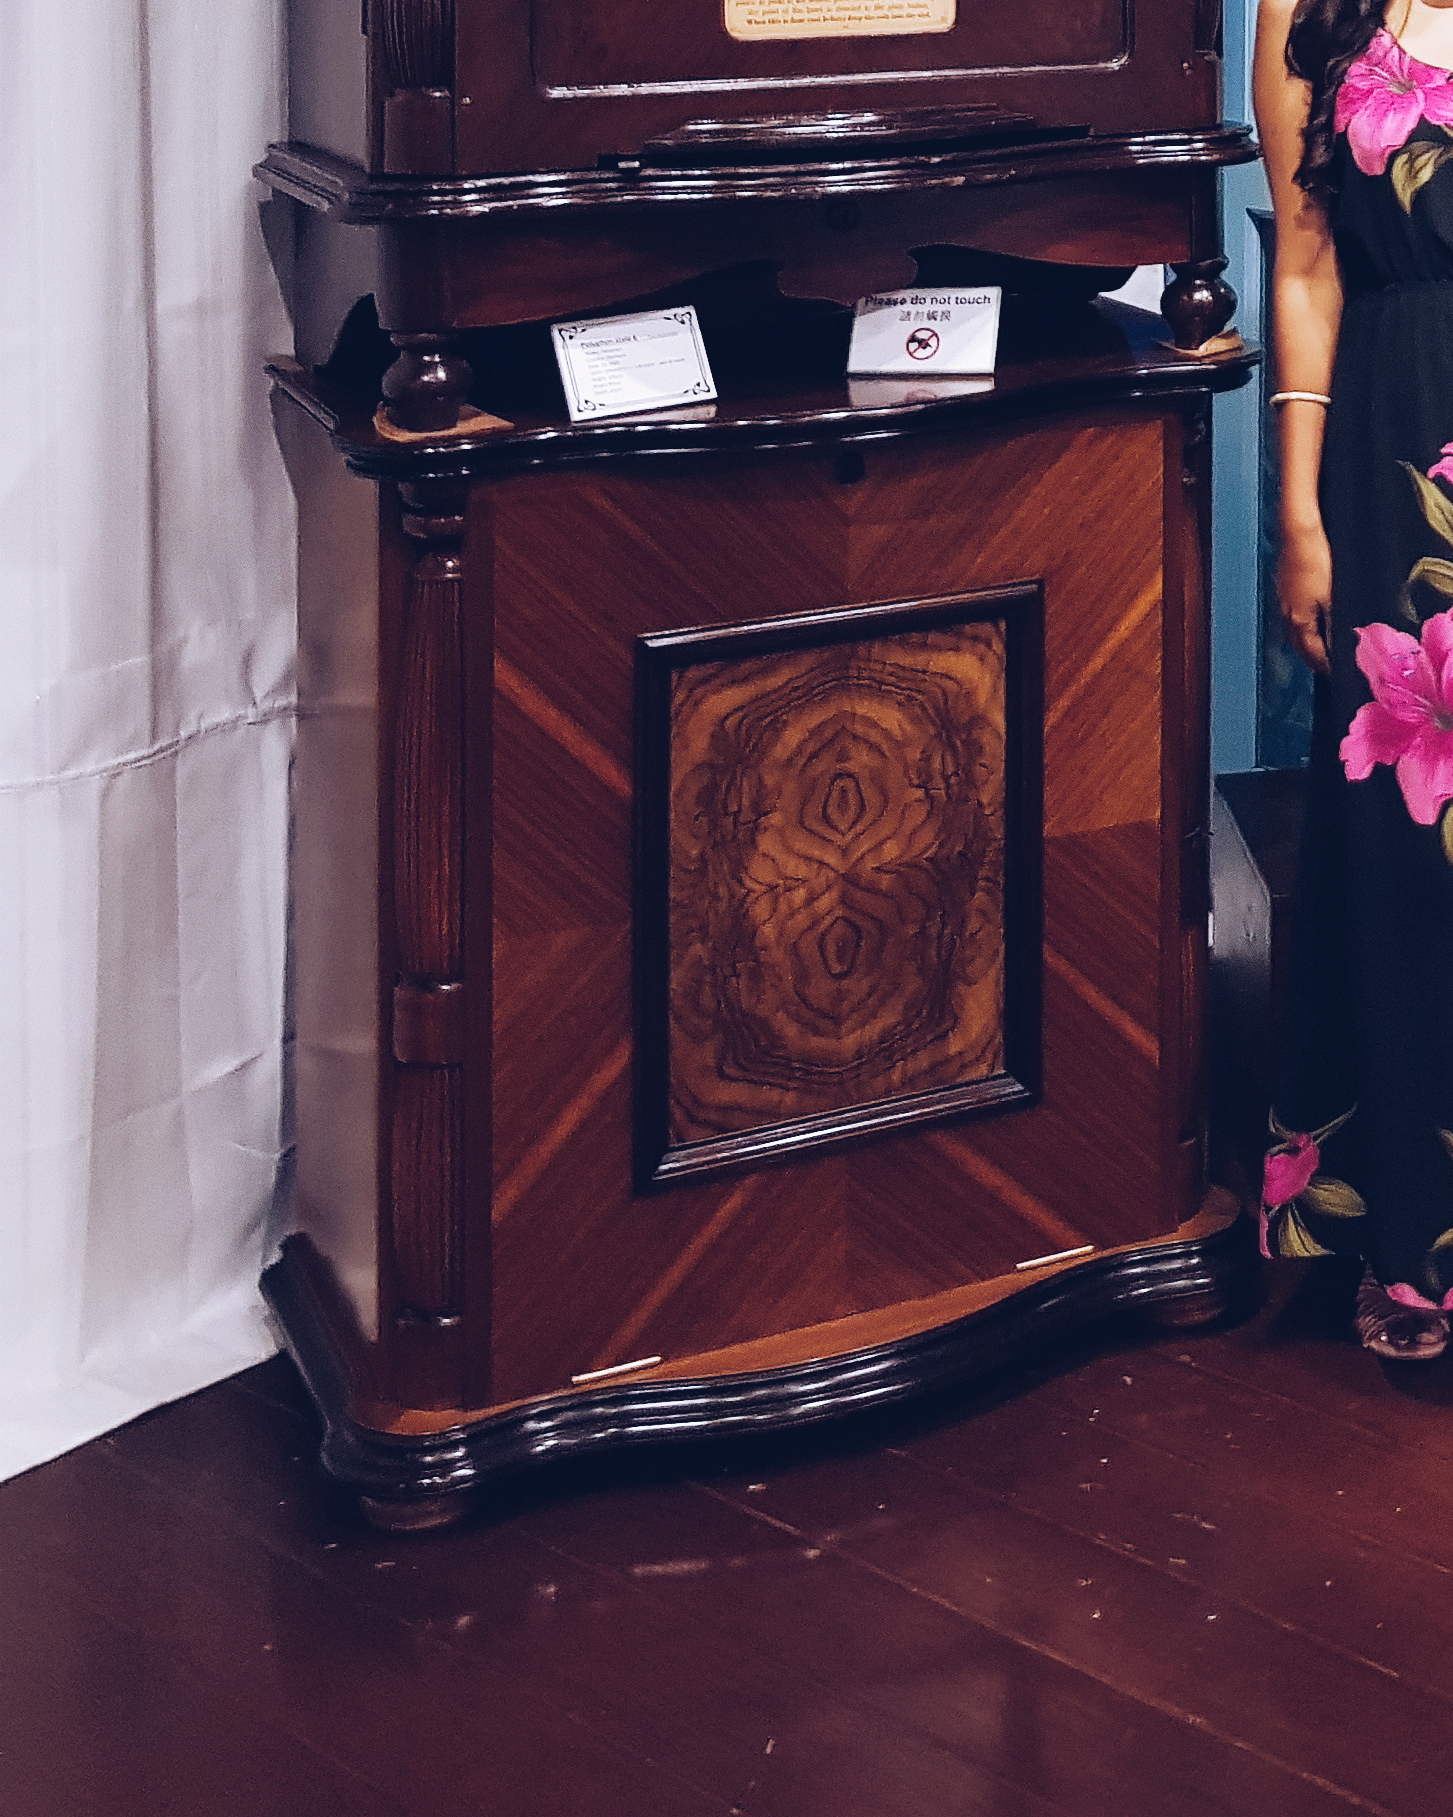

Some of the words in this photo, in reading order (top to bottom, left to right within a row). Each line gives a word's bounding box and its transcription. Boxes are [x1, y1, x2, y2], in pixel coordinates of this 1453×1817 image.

[865, 294, 907, 306] Please
[910, 294, 926, 305] do
[930, 294, 951, 305] not
[955, 294, 991, 305] touch
